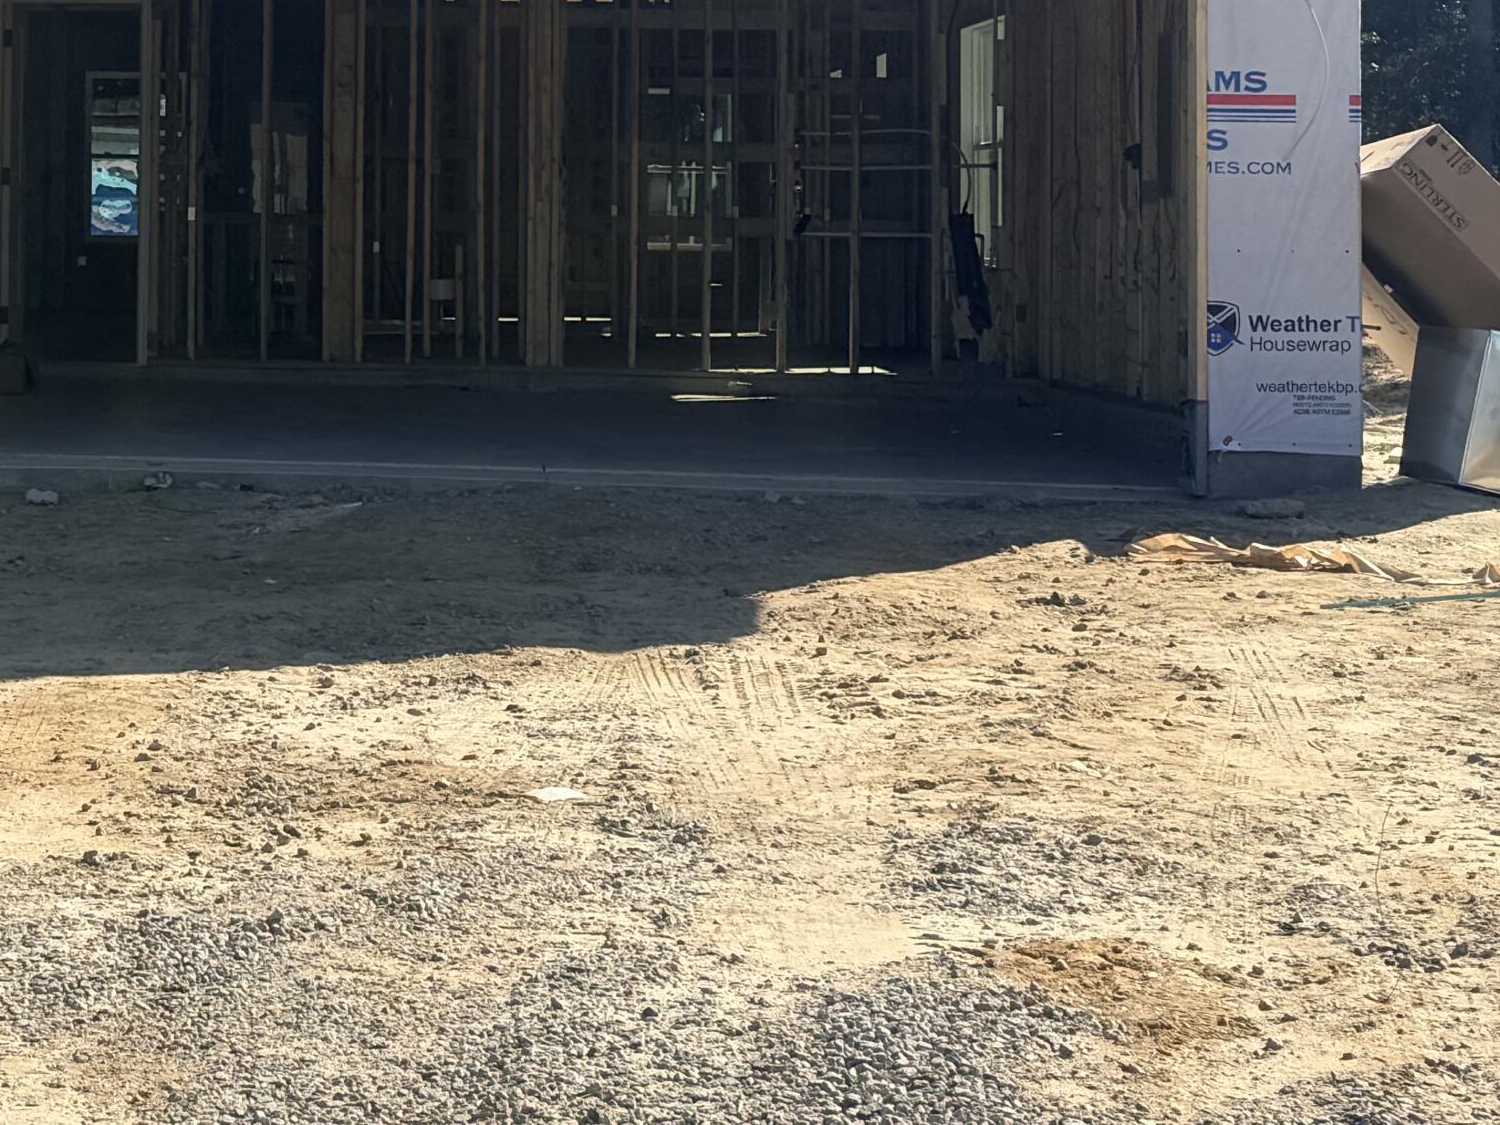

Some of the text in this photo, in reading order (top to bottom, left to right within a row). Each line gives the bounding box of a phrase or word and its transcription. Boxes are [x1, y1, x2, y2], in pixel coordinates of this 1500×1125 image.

[1207, 71, 1268, 93] MS
[1402, 161, 1467, 230] STERLING
[1250, 337, 1352, 354] Housewrap
